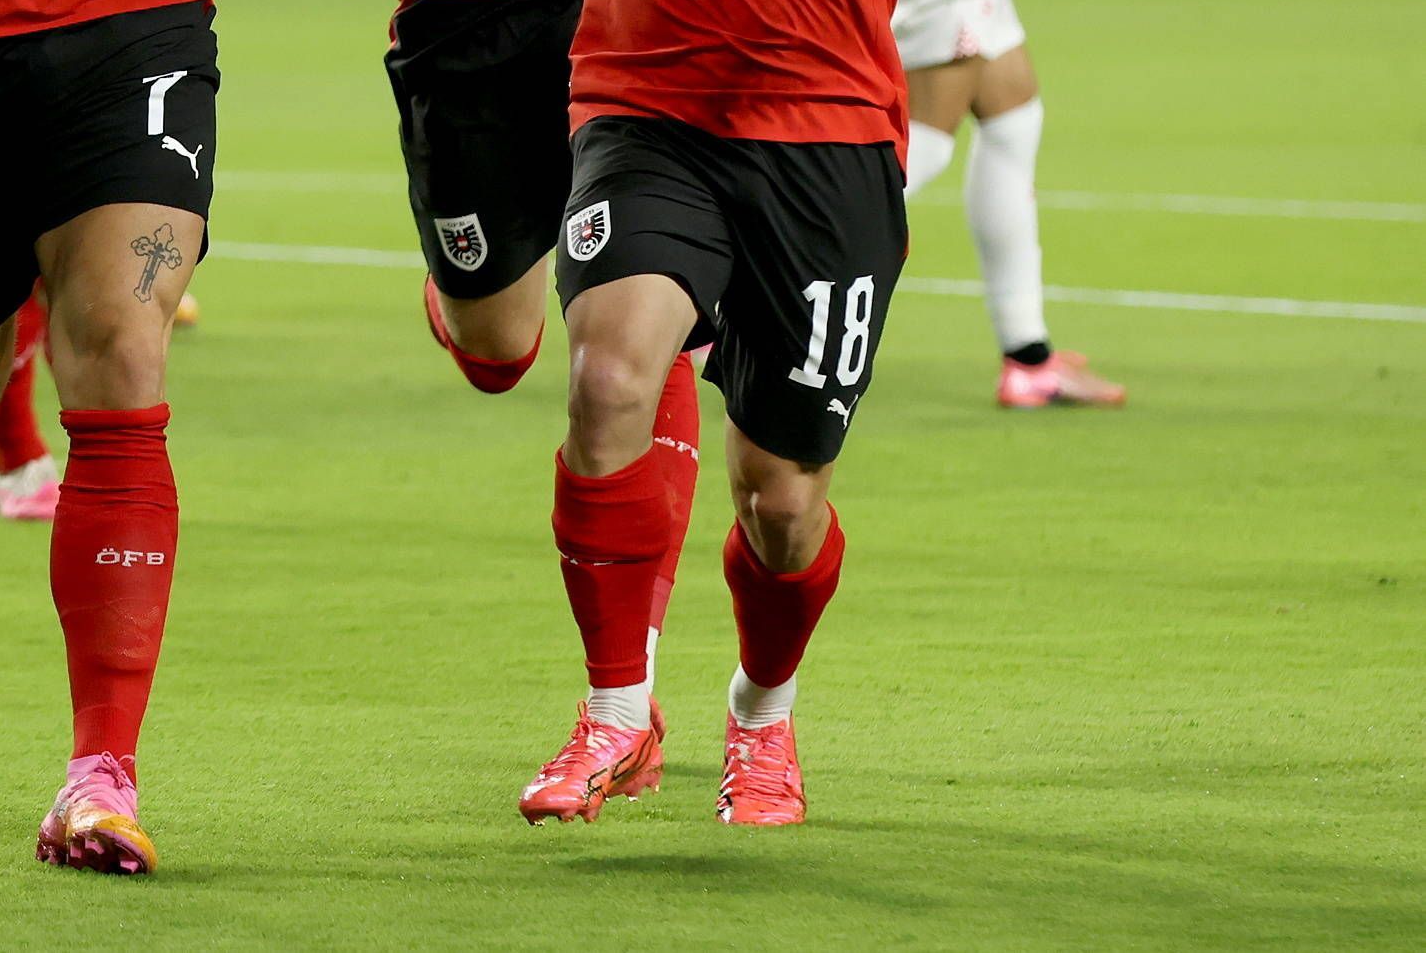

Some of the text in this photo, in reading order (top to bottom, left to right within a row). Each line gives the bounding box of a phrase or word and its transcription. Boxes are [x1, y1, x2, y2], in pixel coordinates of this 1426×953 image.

[142, 70, 188, 136] 7
[788, 274, 875, 389] 18
[95, 547, 165, 567] ÖFB
